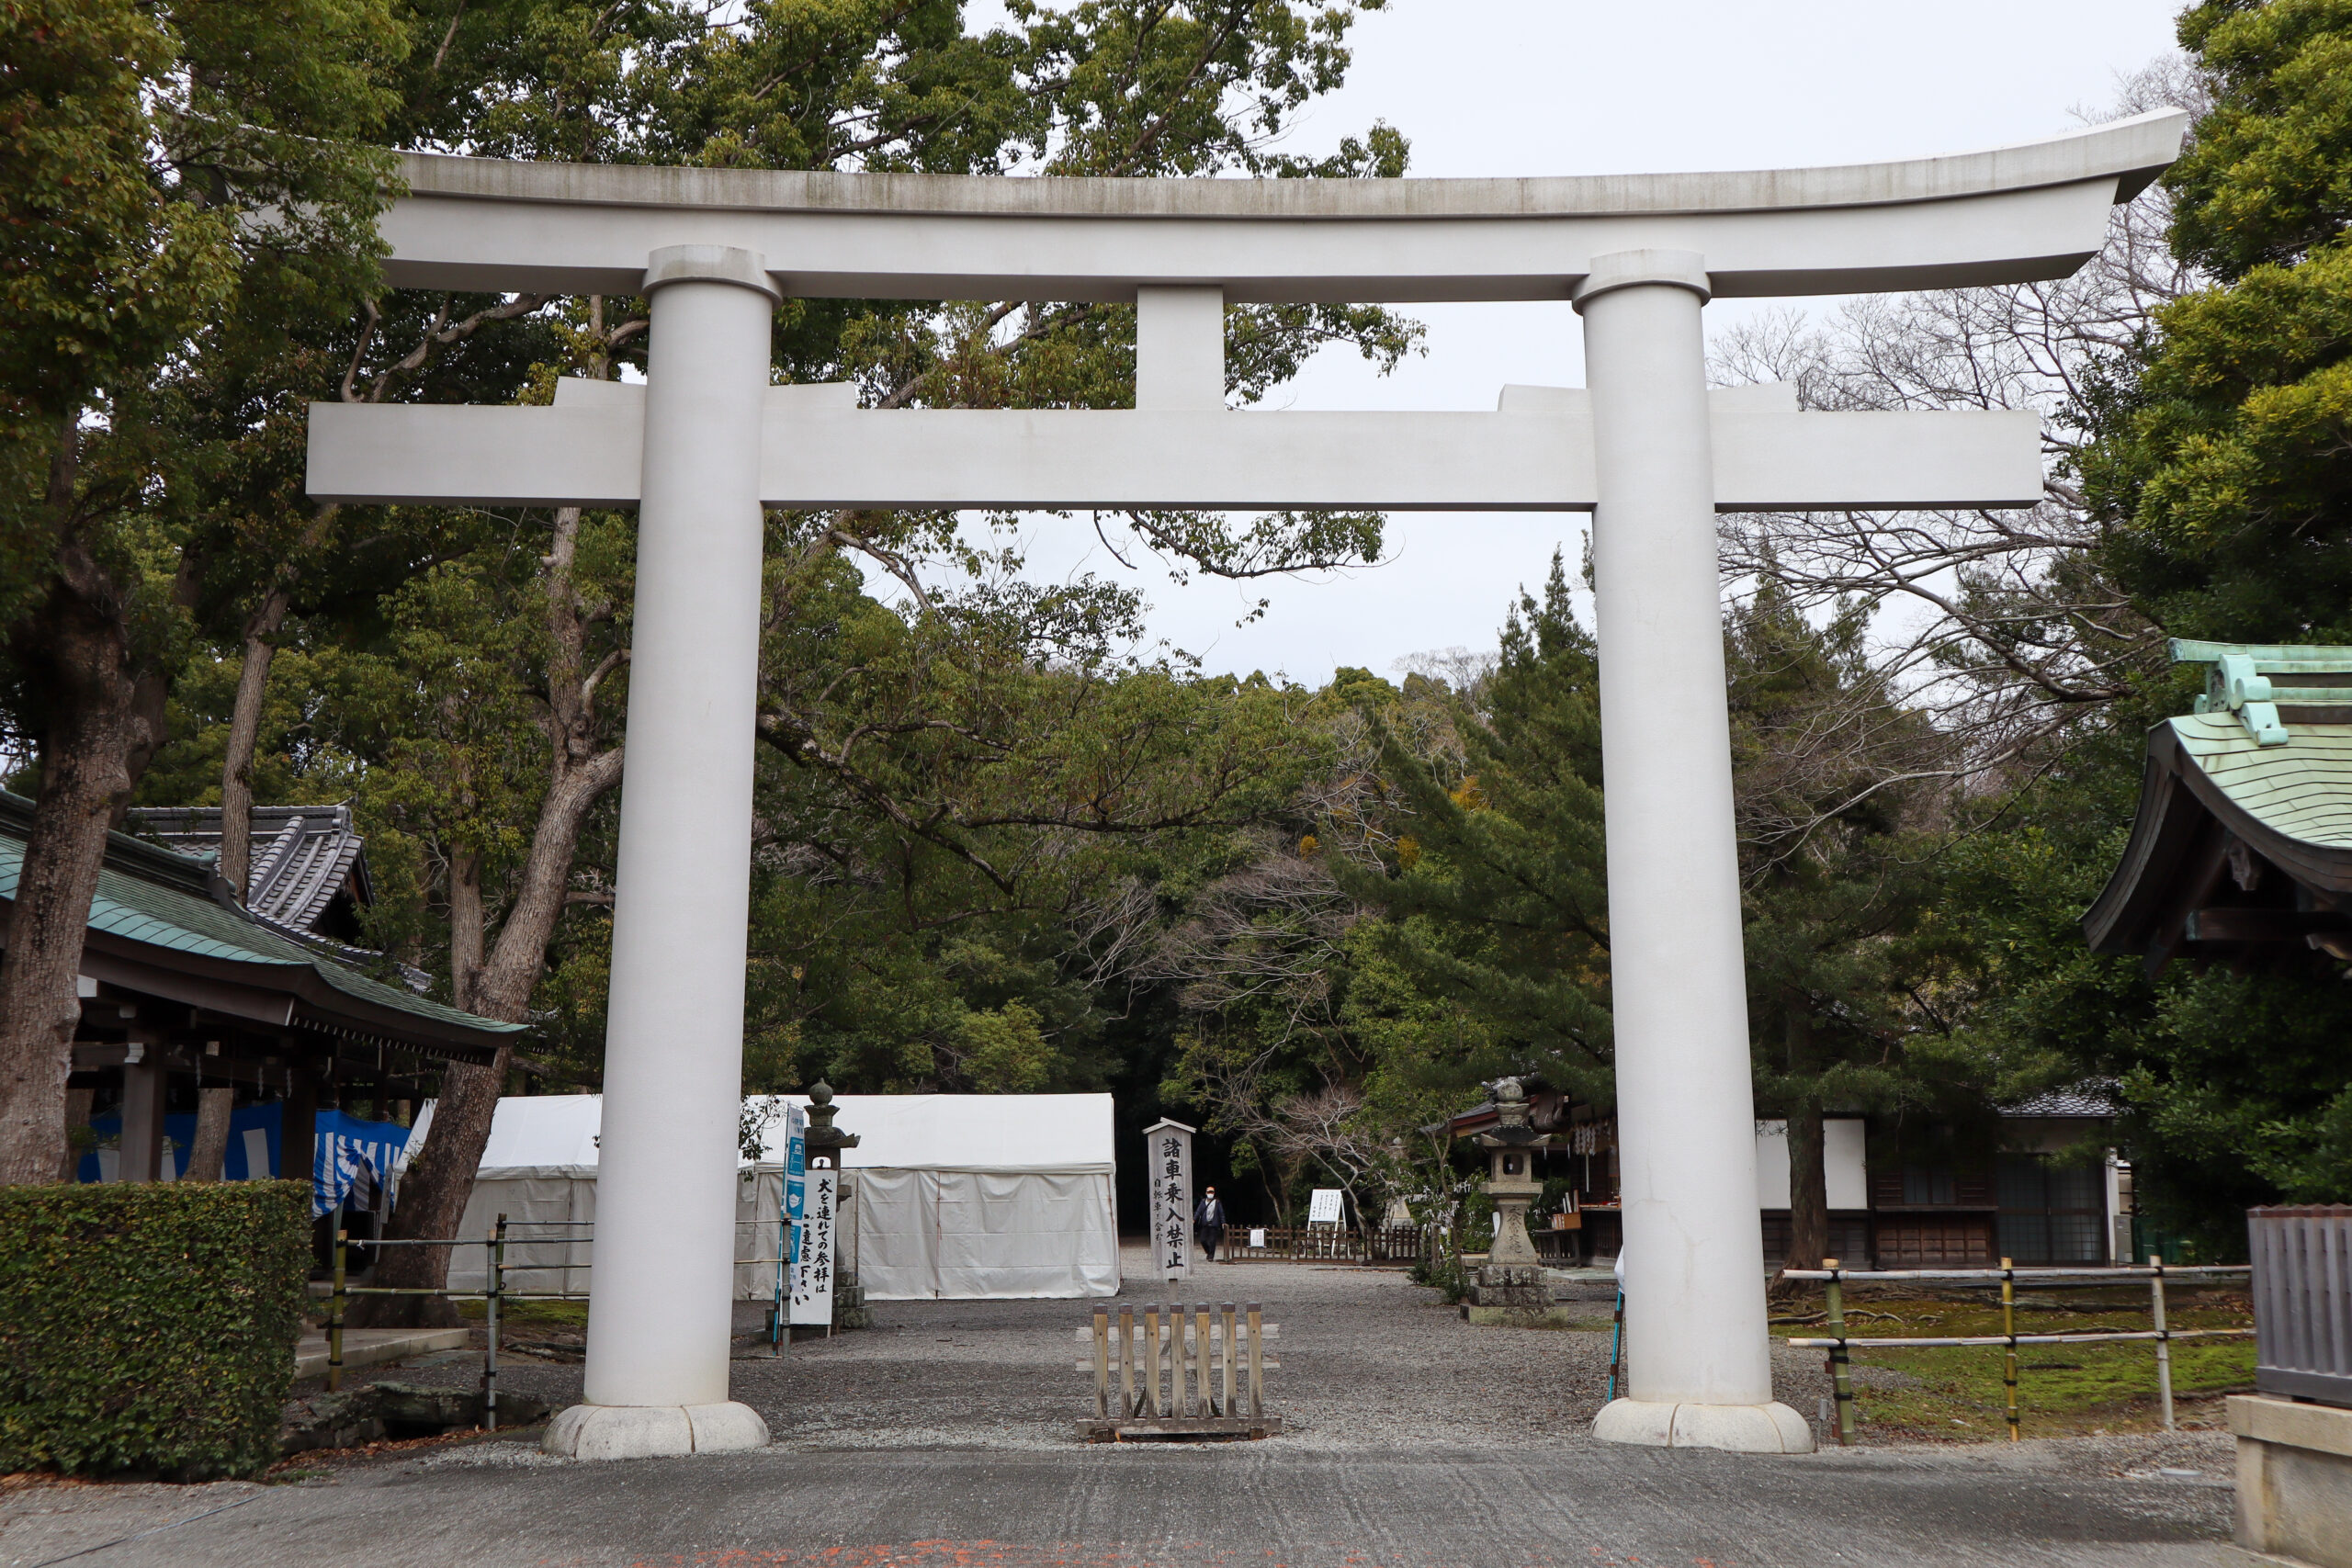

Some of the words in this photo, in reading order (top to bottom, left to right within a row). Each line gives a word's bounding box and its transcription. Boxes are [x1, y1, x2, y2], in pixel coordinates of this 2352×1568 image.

[795, 1213, 814, 1305] ご遠慮下さい
[813, 1178, 833, 1293] 犬を連れての参拝は
[1162, 1137, 1185, 1269] 諸車乗入禁止
